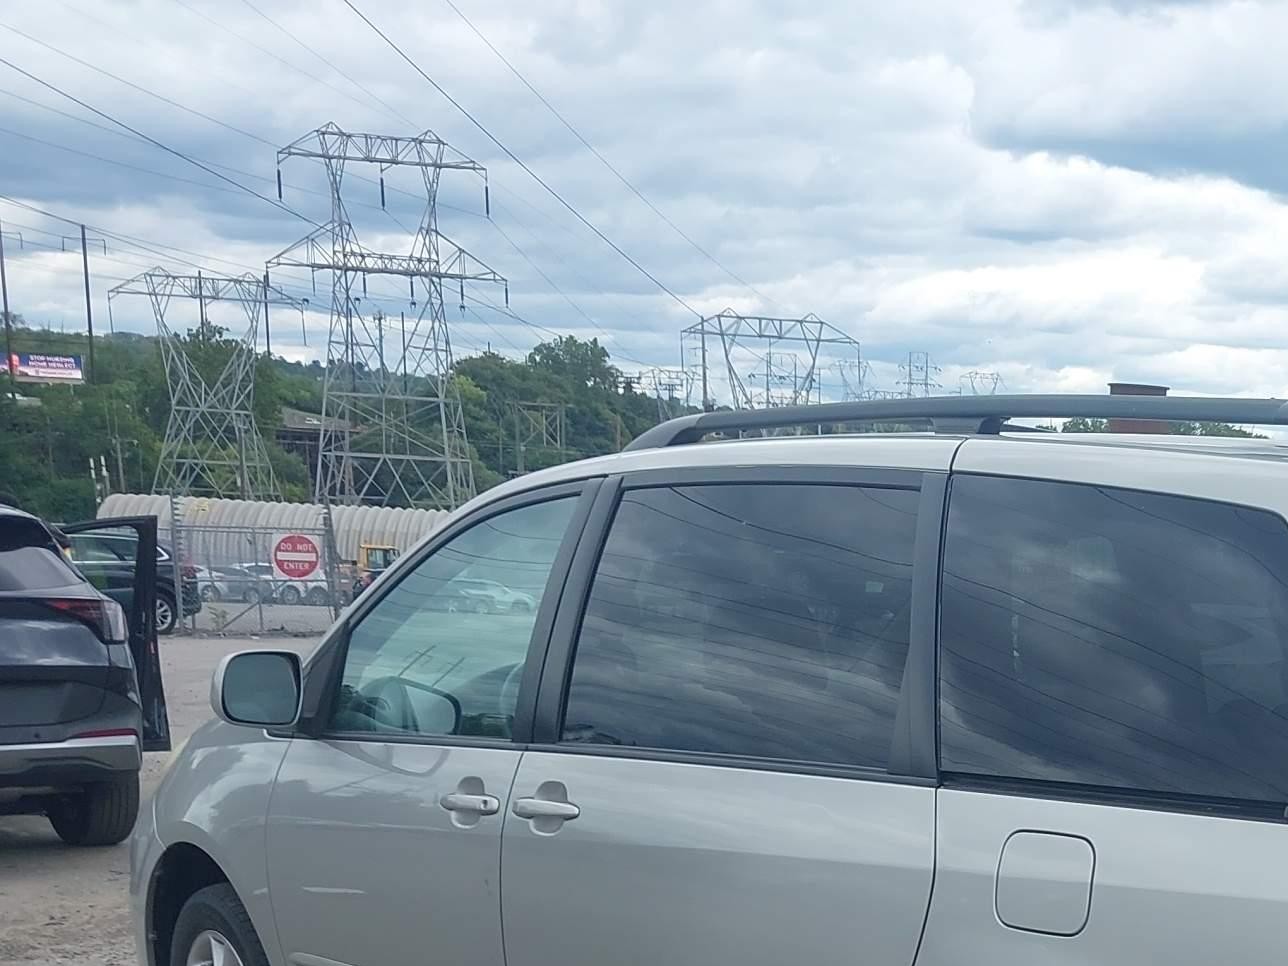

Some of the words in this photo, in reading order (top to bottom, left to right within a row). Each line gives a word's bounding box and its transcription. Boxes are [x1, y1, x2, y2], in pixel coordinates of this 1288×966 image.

[280, 542, 293, 551] DO
[295, 543, 313, 552] NOT
[283, 561, 310, 570] ENTER
